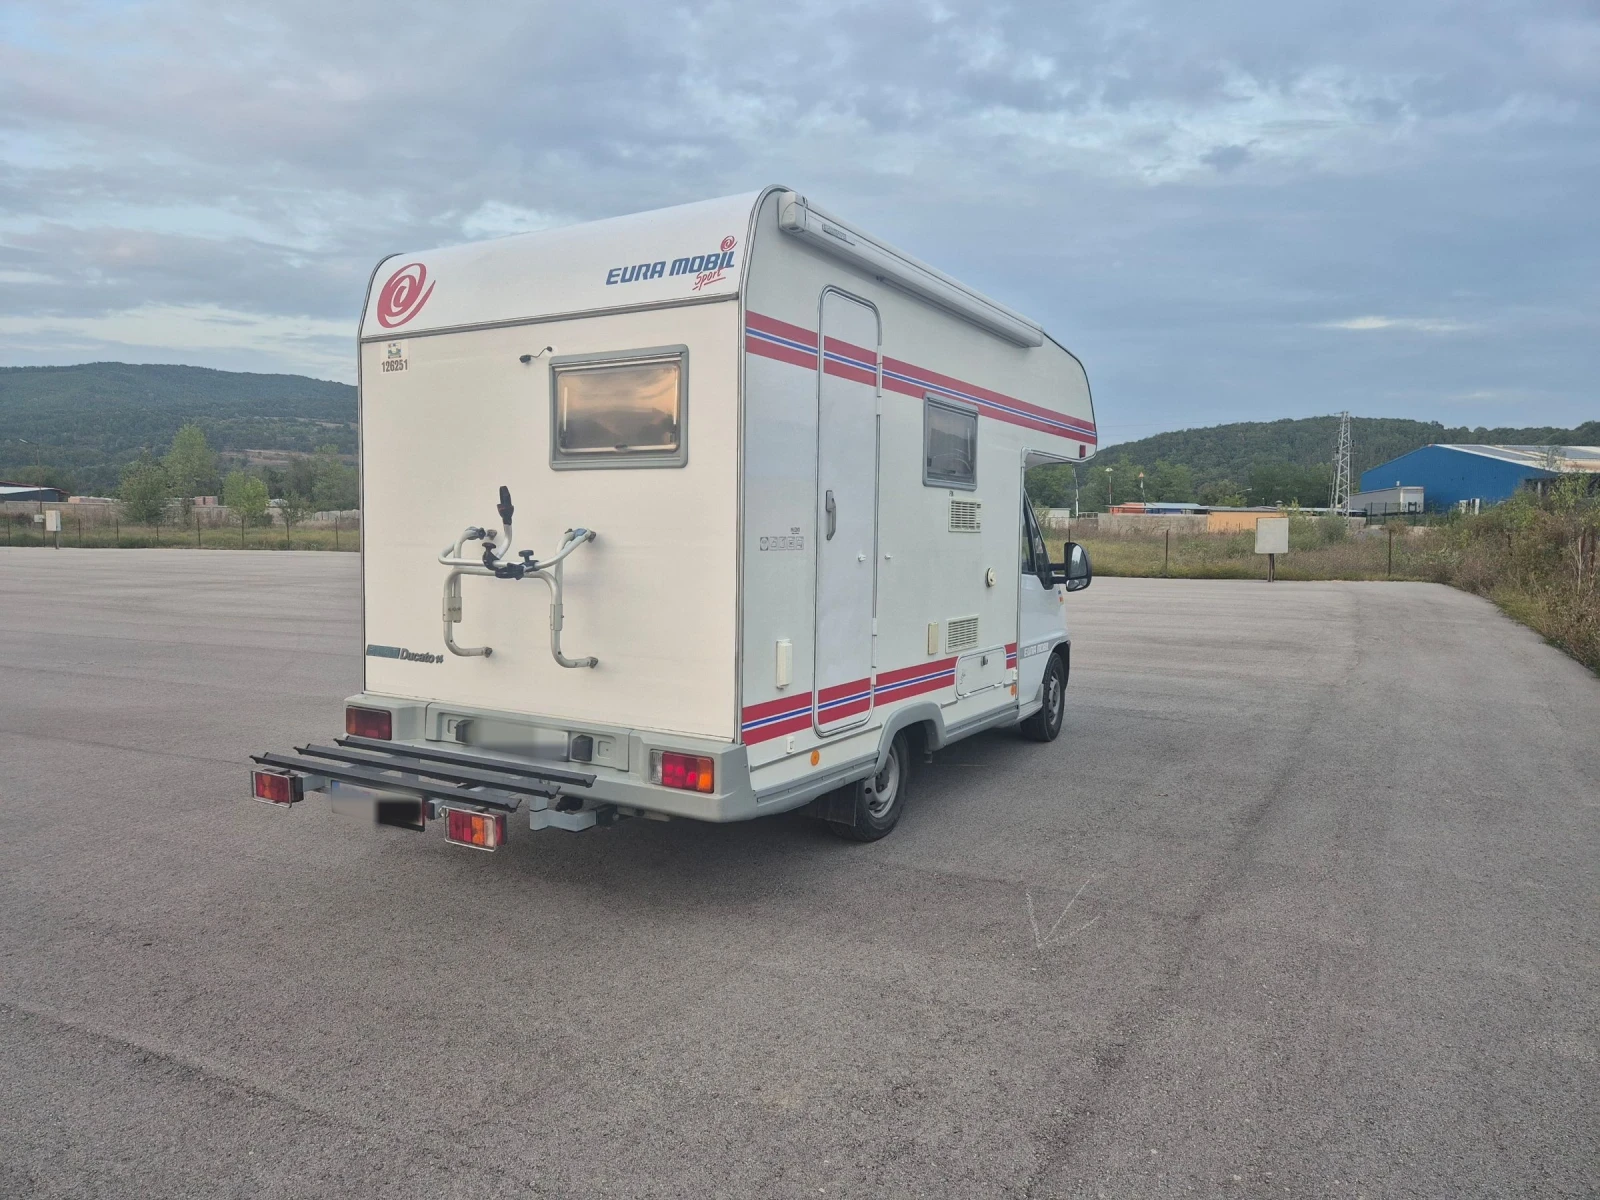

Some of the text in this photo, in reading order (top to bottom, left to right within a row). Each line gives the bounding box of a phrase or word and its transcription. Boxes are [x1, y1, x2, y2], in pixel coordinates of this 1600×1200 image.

[606, 251, 735, 285] EURA MOBIL
[693, 267, 726, 290] Sport
[381, 359, 408, 373] 126251
[400, 648, 435, 663] Ducato
